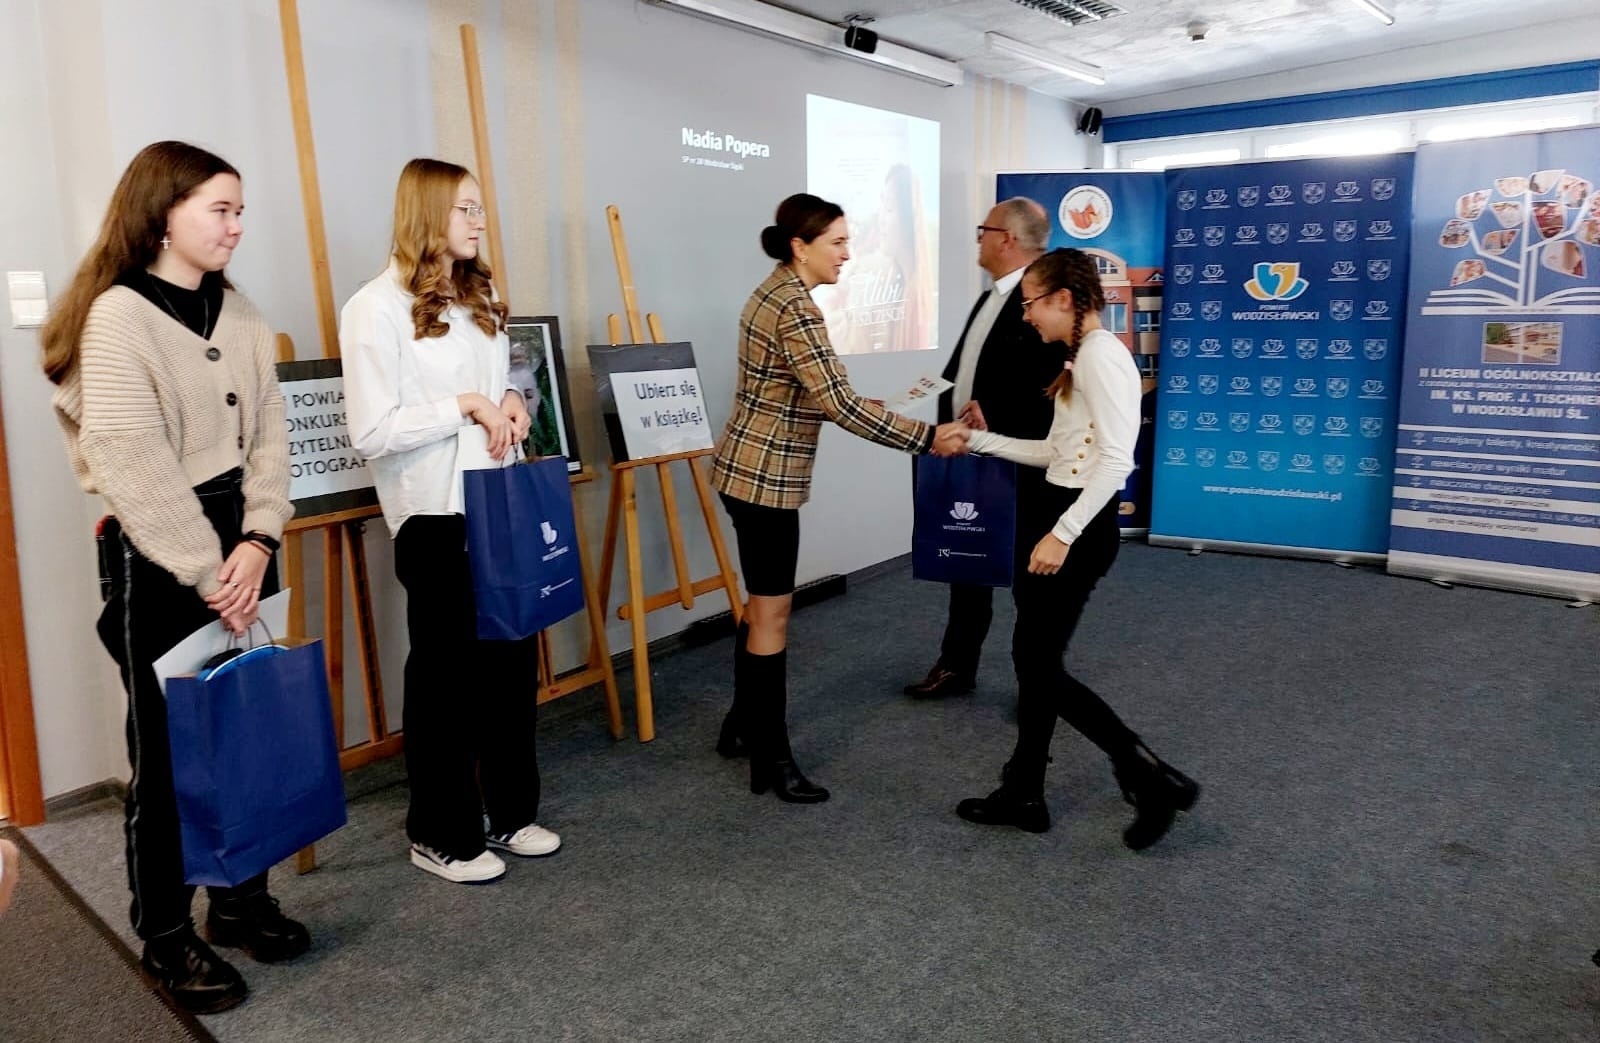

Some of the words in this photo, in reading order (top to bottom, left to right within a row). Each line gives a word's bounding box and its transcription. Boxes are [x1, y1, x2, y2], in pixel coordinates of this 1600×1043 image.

[682, 127, 722, 150] Nadia
[725, 134, 770, 158] Popera
[1231, 311, 1320, 321] WODZISŁAWSKI
[1430, 368, 1480, 379] LICEUM
[634, 382, 677, 400] Ubierz
[680, 380, 697, 398] się
[1453, 390, 1475, 401] KS.
[1477, 391, 1515, 402] PROF.
[640, 415, 651, 428] w
[654, 405, 703, 428] książkę!
[1451, 403, 1465, 414] W
[1466, 404, 1562, 418] WODZISŁAWIU
